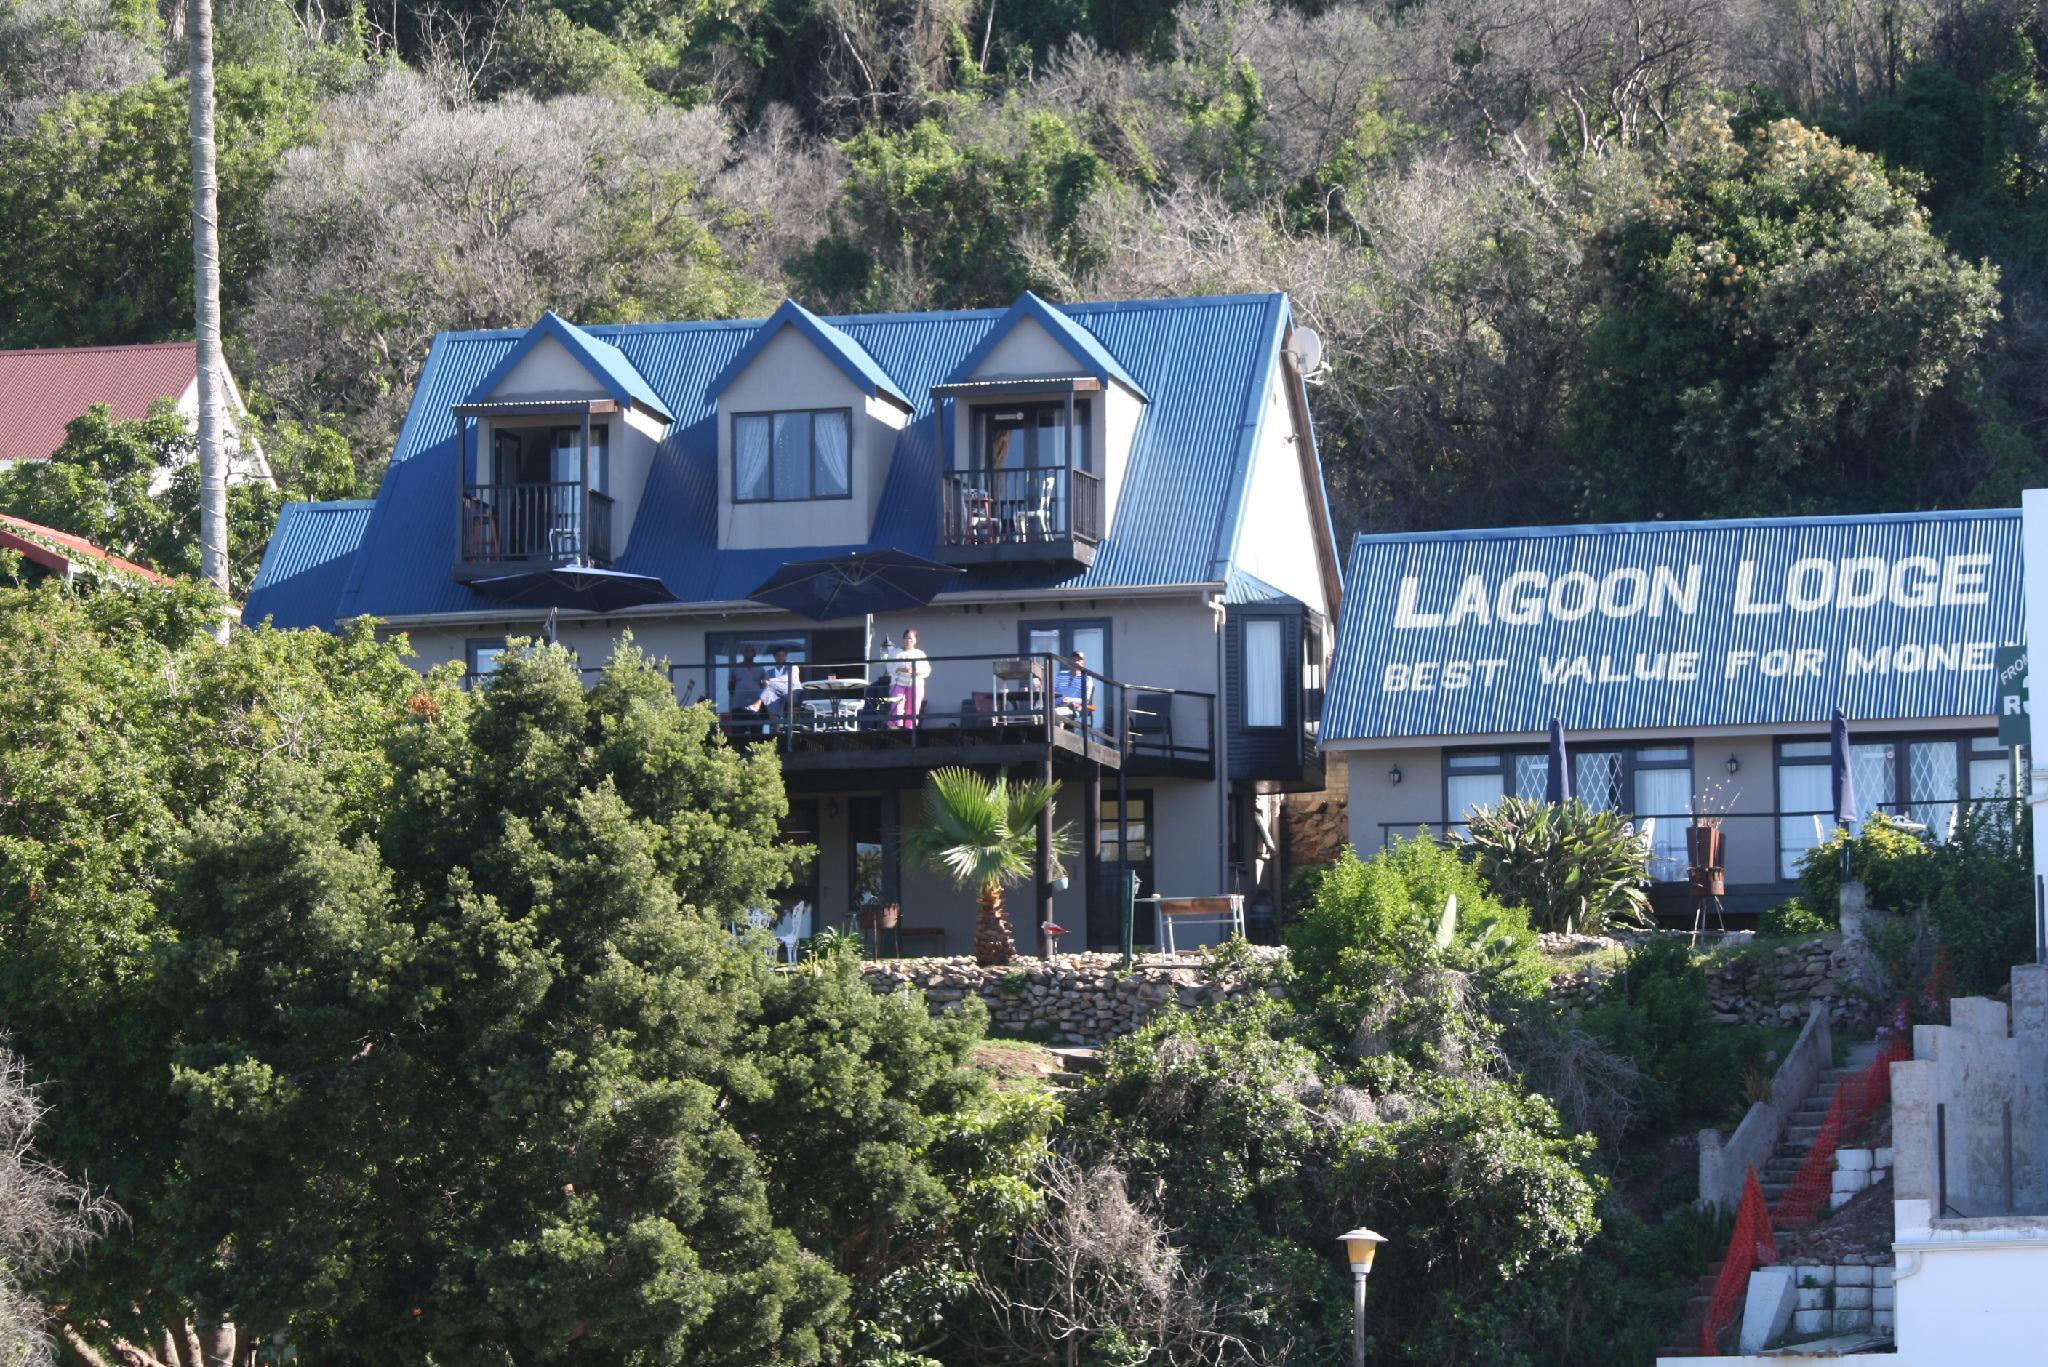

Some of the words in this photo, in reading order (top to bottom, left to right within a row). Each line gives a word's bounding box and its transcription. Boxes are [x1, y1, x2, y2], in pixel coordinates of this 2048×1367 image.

[1393, 564, 1701, 629] LAGOON
[1733, 553, 1992, 615] LODGE
[1383, 659, 1506, 692] BEST
[1539, 651, 1700, 685] VALUE
[1724, 648, 1826, 680] FOR
[1846, 640, 2018, 676] MONE
